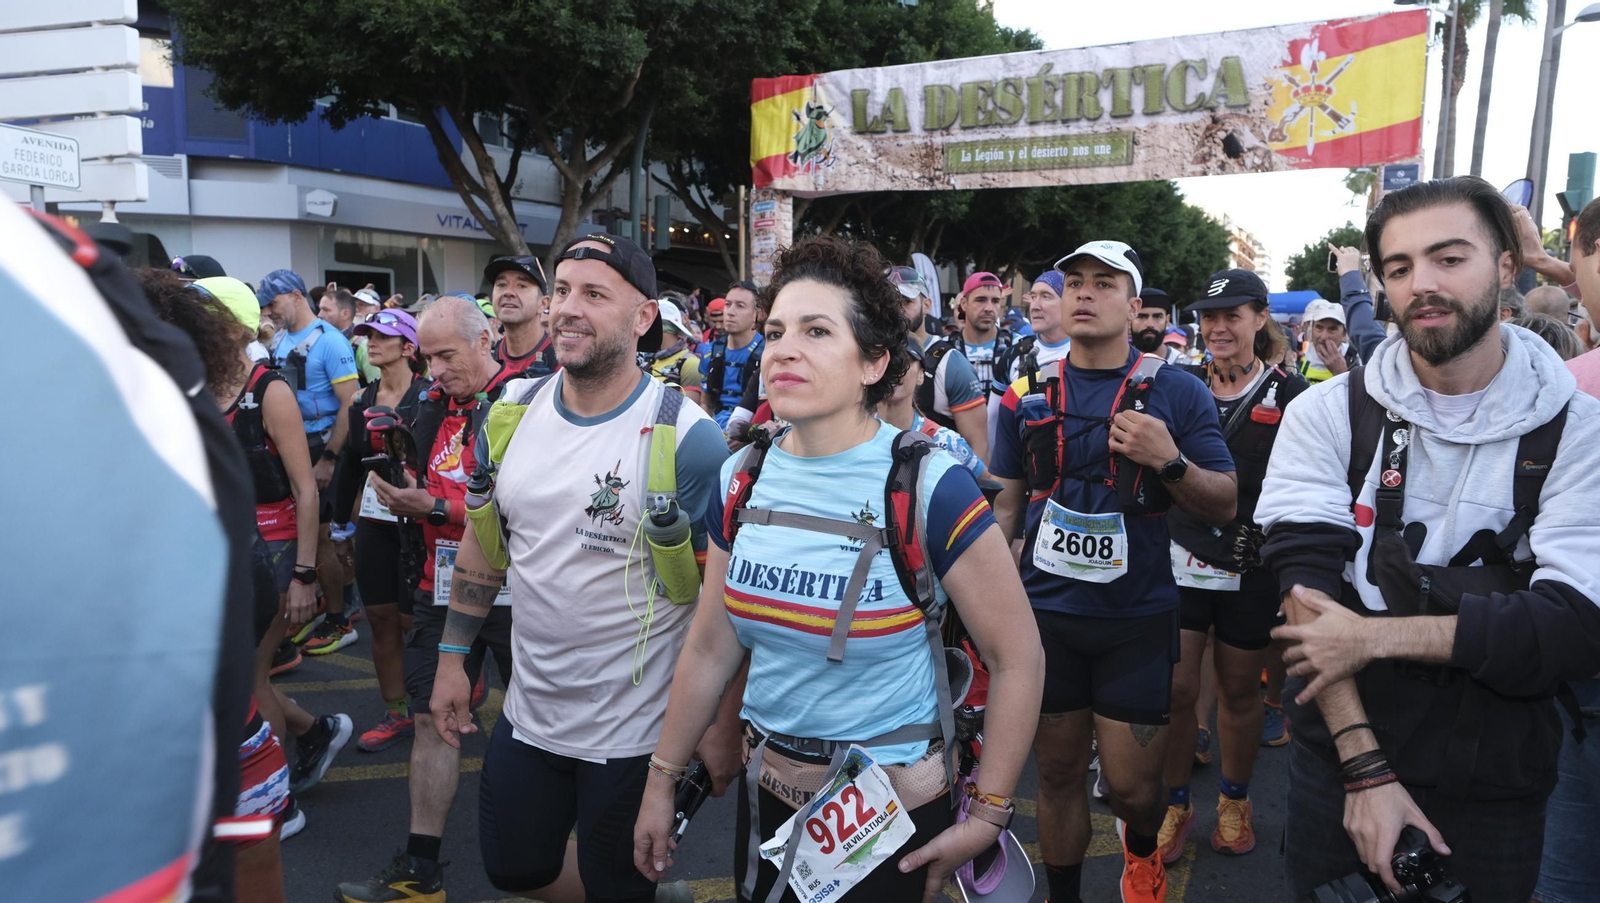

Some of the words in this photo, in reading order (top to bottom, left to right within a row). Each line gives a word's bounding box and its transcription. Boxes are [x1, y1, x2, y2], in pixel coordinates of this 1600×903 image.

[851, 87, 911, 134] LA
[922, 55, 1250, 131] DESÉRTICA
[21, 136, 75, 153] AVENIDA
[961, 150, 972, 162] La
[975, 146, 1005, 163] Legión
[1009, 149, 1016, 162] y
[1019, 145, 1028, 159] el
[1031, 142, 1069, 159] desierto
[1072, 144, 1090, 156] nos
[1094, 142, 1112, 156] une
[14, 147, 63, 168] FEDERICO
[2, 160, 41, 179] GARCÍA
[43, 166, 75, 184] LORCA
[575, 527, 584, 535] LA
[584, 529, 627, 543] DESÉRTICA
[1051, 527, 1114, 560] 2608
[580, 542, 587, 550] VI
[588, 544, 615, 554] EDICIÓN
[1087, 558, 1112, 566] JOAQUIN
[736, 558, 884, 602] DESÉRTIA
[805, 785, 878, 855] 922
[807, 878, 821, 892] BUS
[808, 881, 835, 903] asisa
